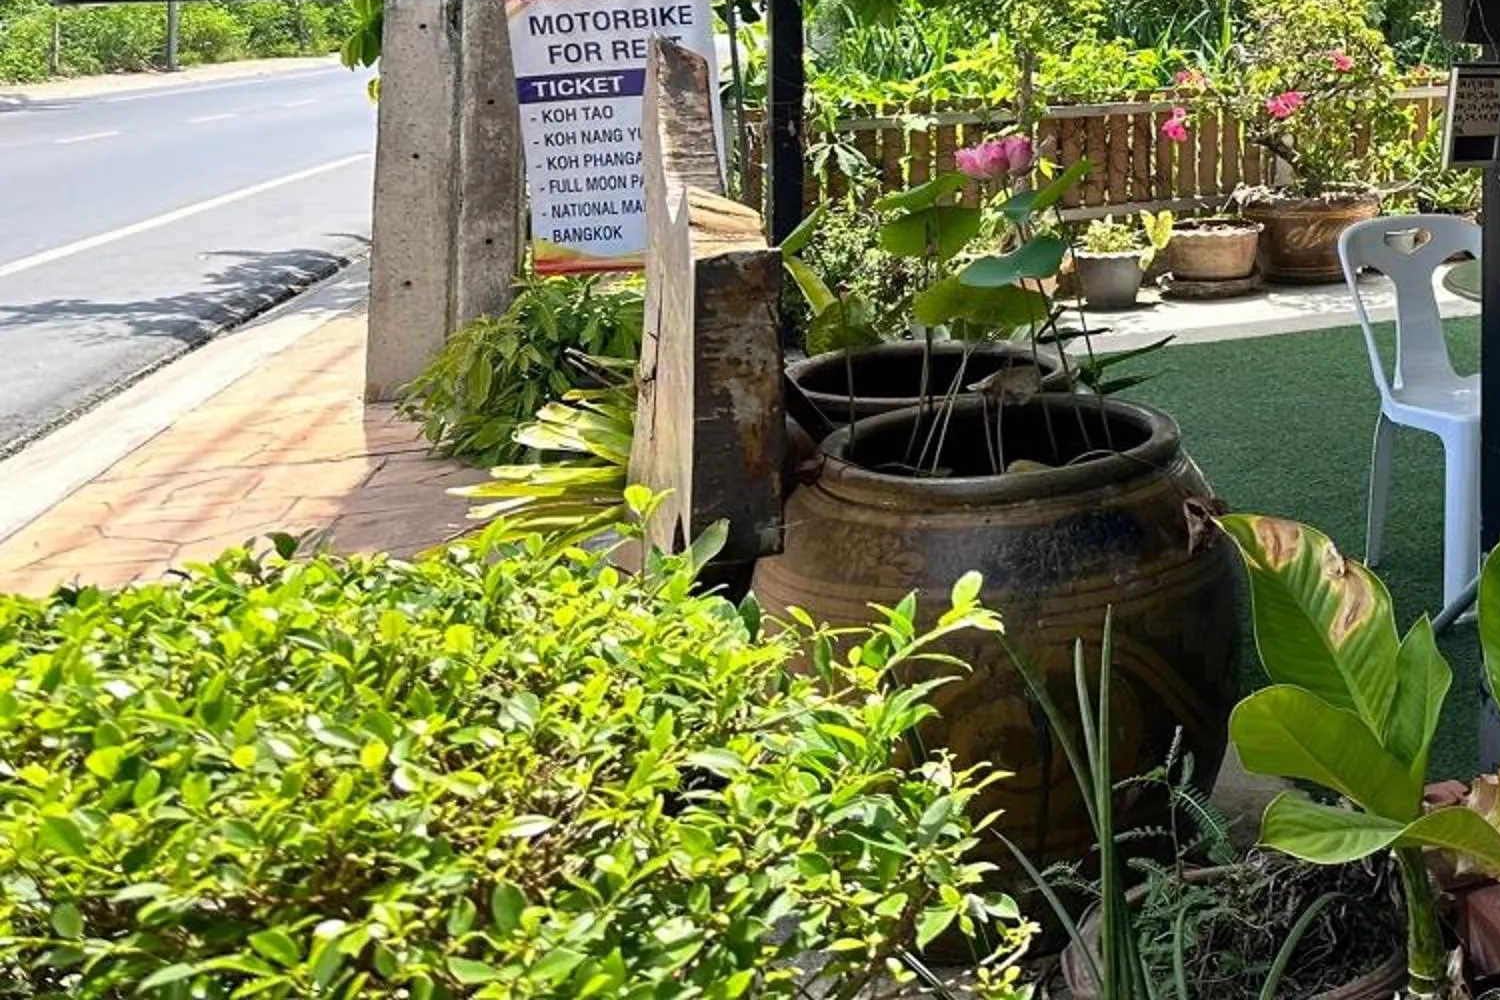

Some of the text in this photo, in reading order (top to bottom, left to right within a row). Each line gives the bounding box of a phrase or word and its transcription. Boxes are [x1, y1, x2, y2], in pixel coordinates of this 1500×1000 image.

[529, 5, 693, 36] MOTORBIKE
[547, 41, 602, 64] FOR
[531, 75, 625, 97] TICKET
[541, 105, 613, 124] KOH TAO
[544, 131, 577, 147] KOH
[581, 127, 623, 144] NANG
[547, 154, 579, 170] KOH
[549, 177, 582, 194] FULL
[586, 175, 627, 191] MOON
[551, 199, 646, 219] NATIONAL MA
[553, 225, 623, 243] BANGKOK
